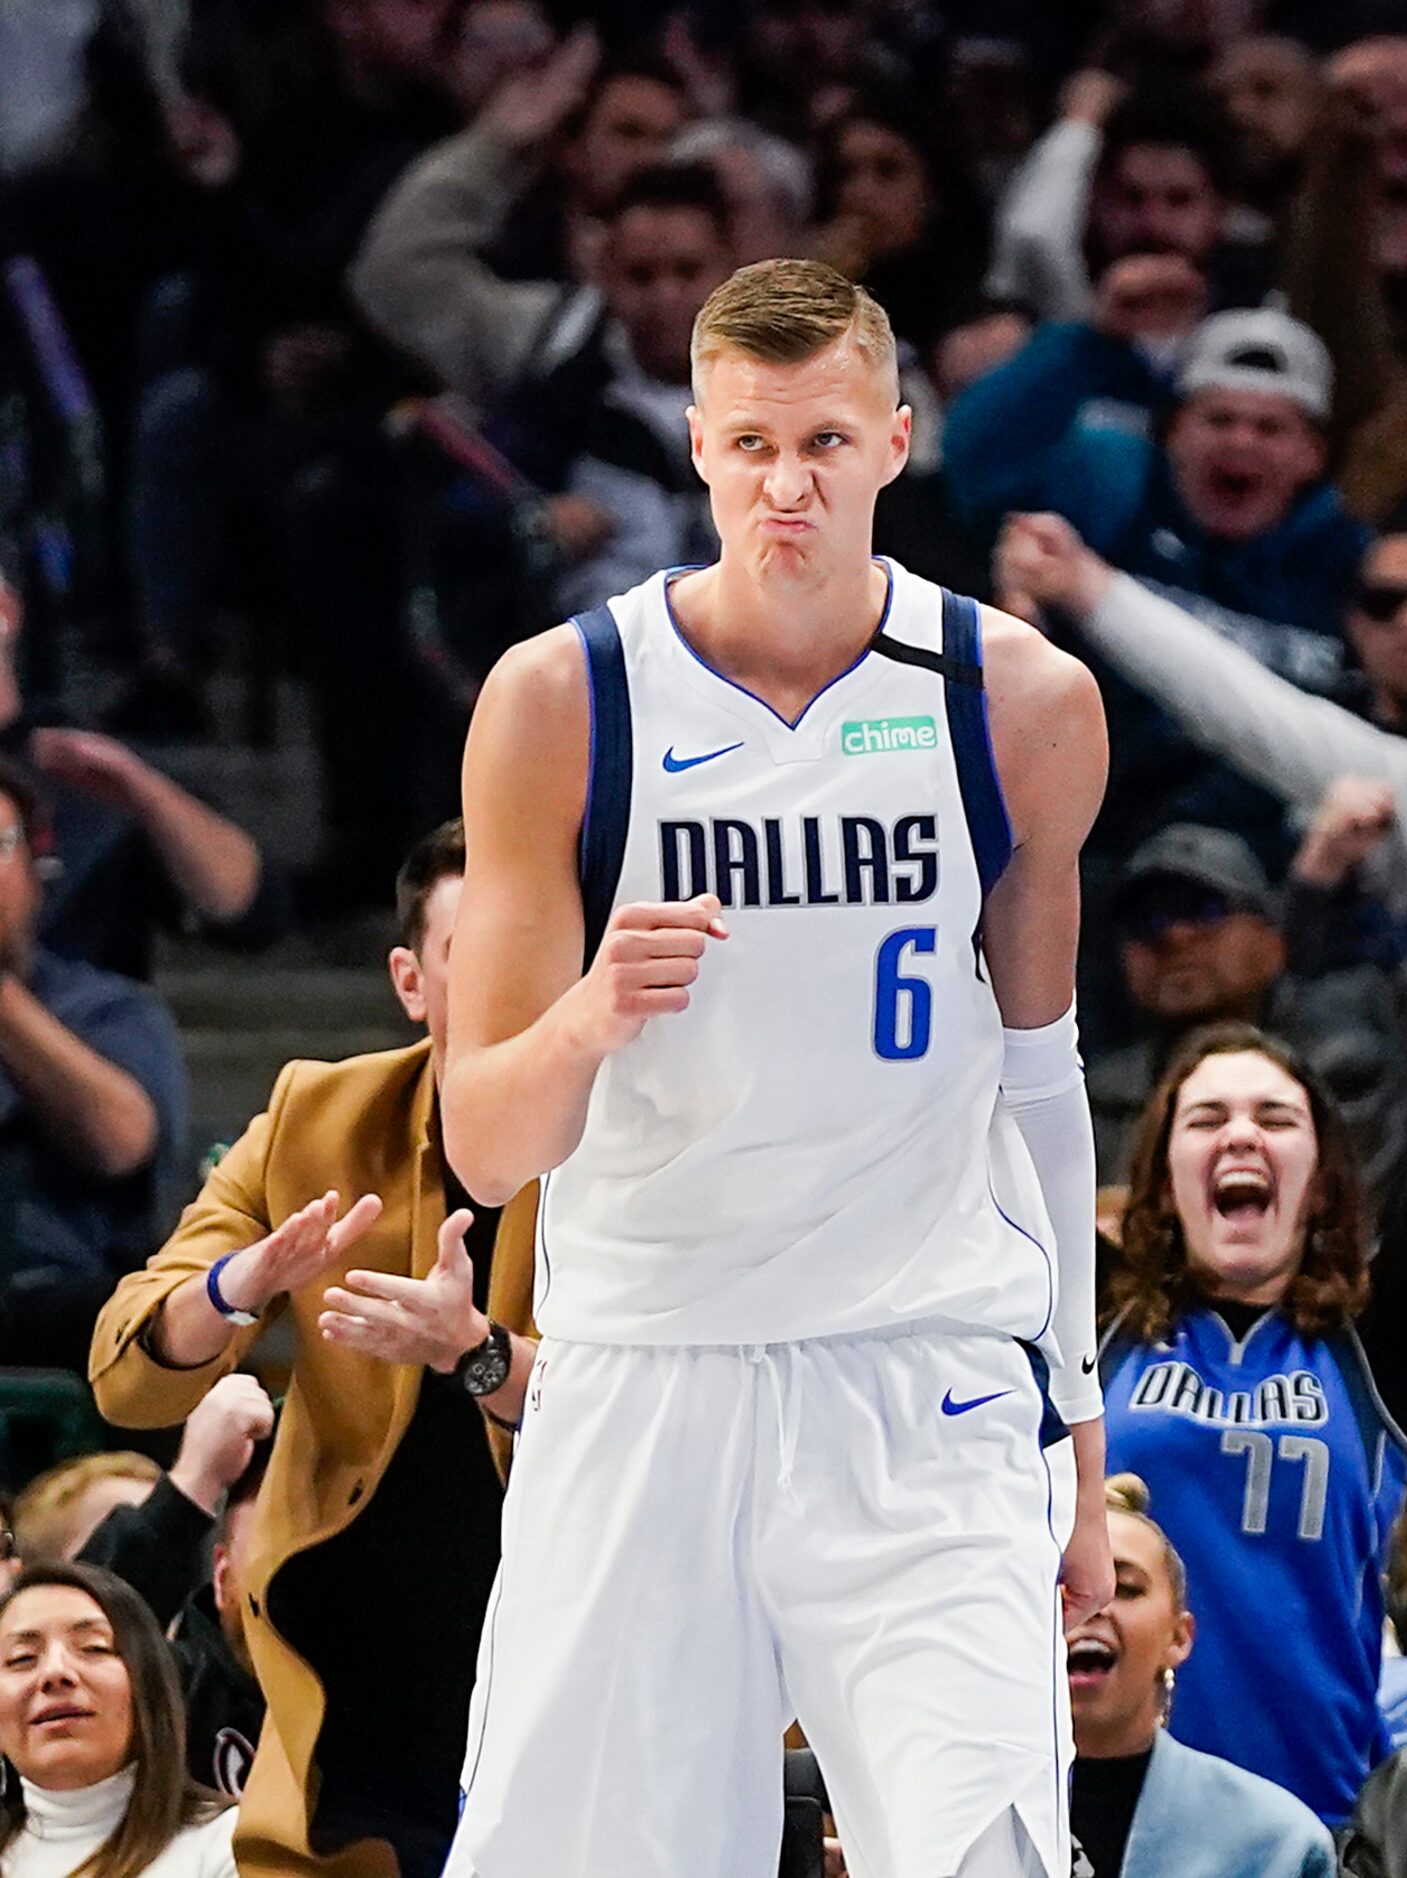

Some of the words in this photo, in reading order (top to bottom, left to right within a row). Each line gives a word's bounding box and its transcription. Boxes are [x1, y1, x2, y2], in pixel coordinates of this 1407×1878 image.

[844, 720, 936, 753] chime
[658, 814, 939, 907] DALLAS
[872, 925, 937, 1062] 6
[1129, 1361, 1329, 1429] DALLAS
[1221, 1429, 1330, 1540] 77
